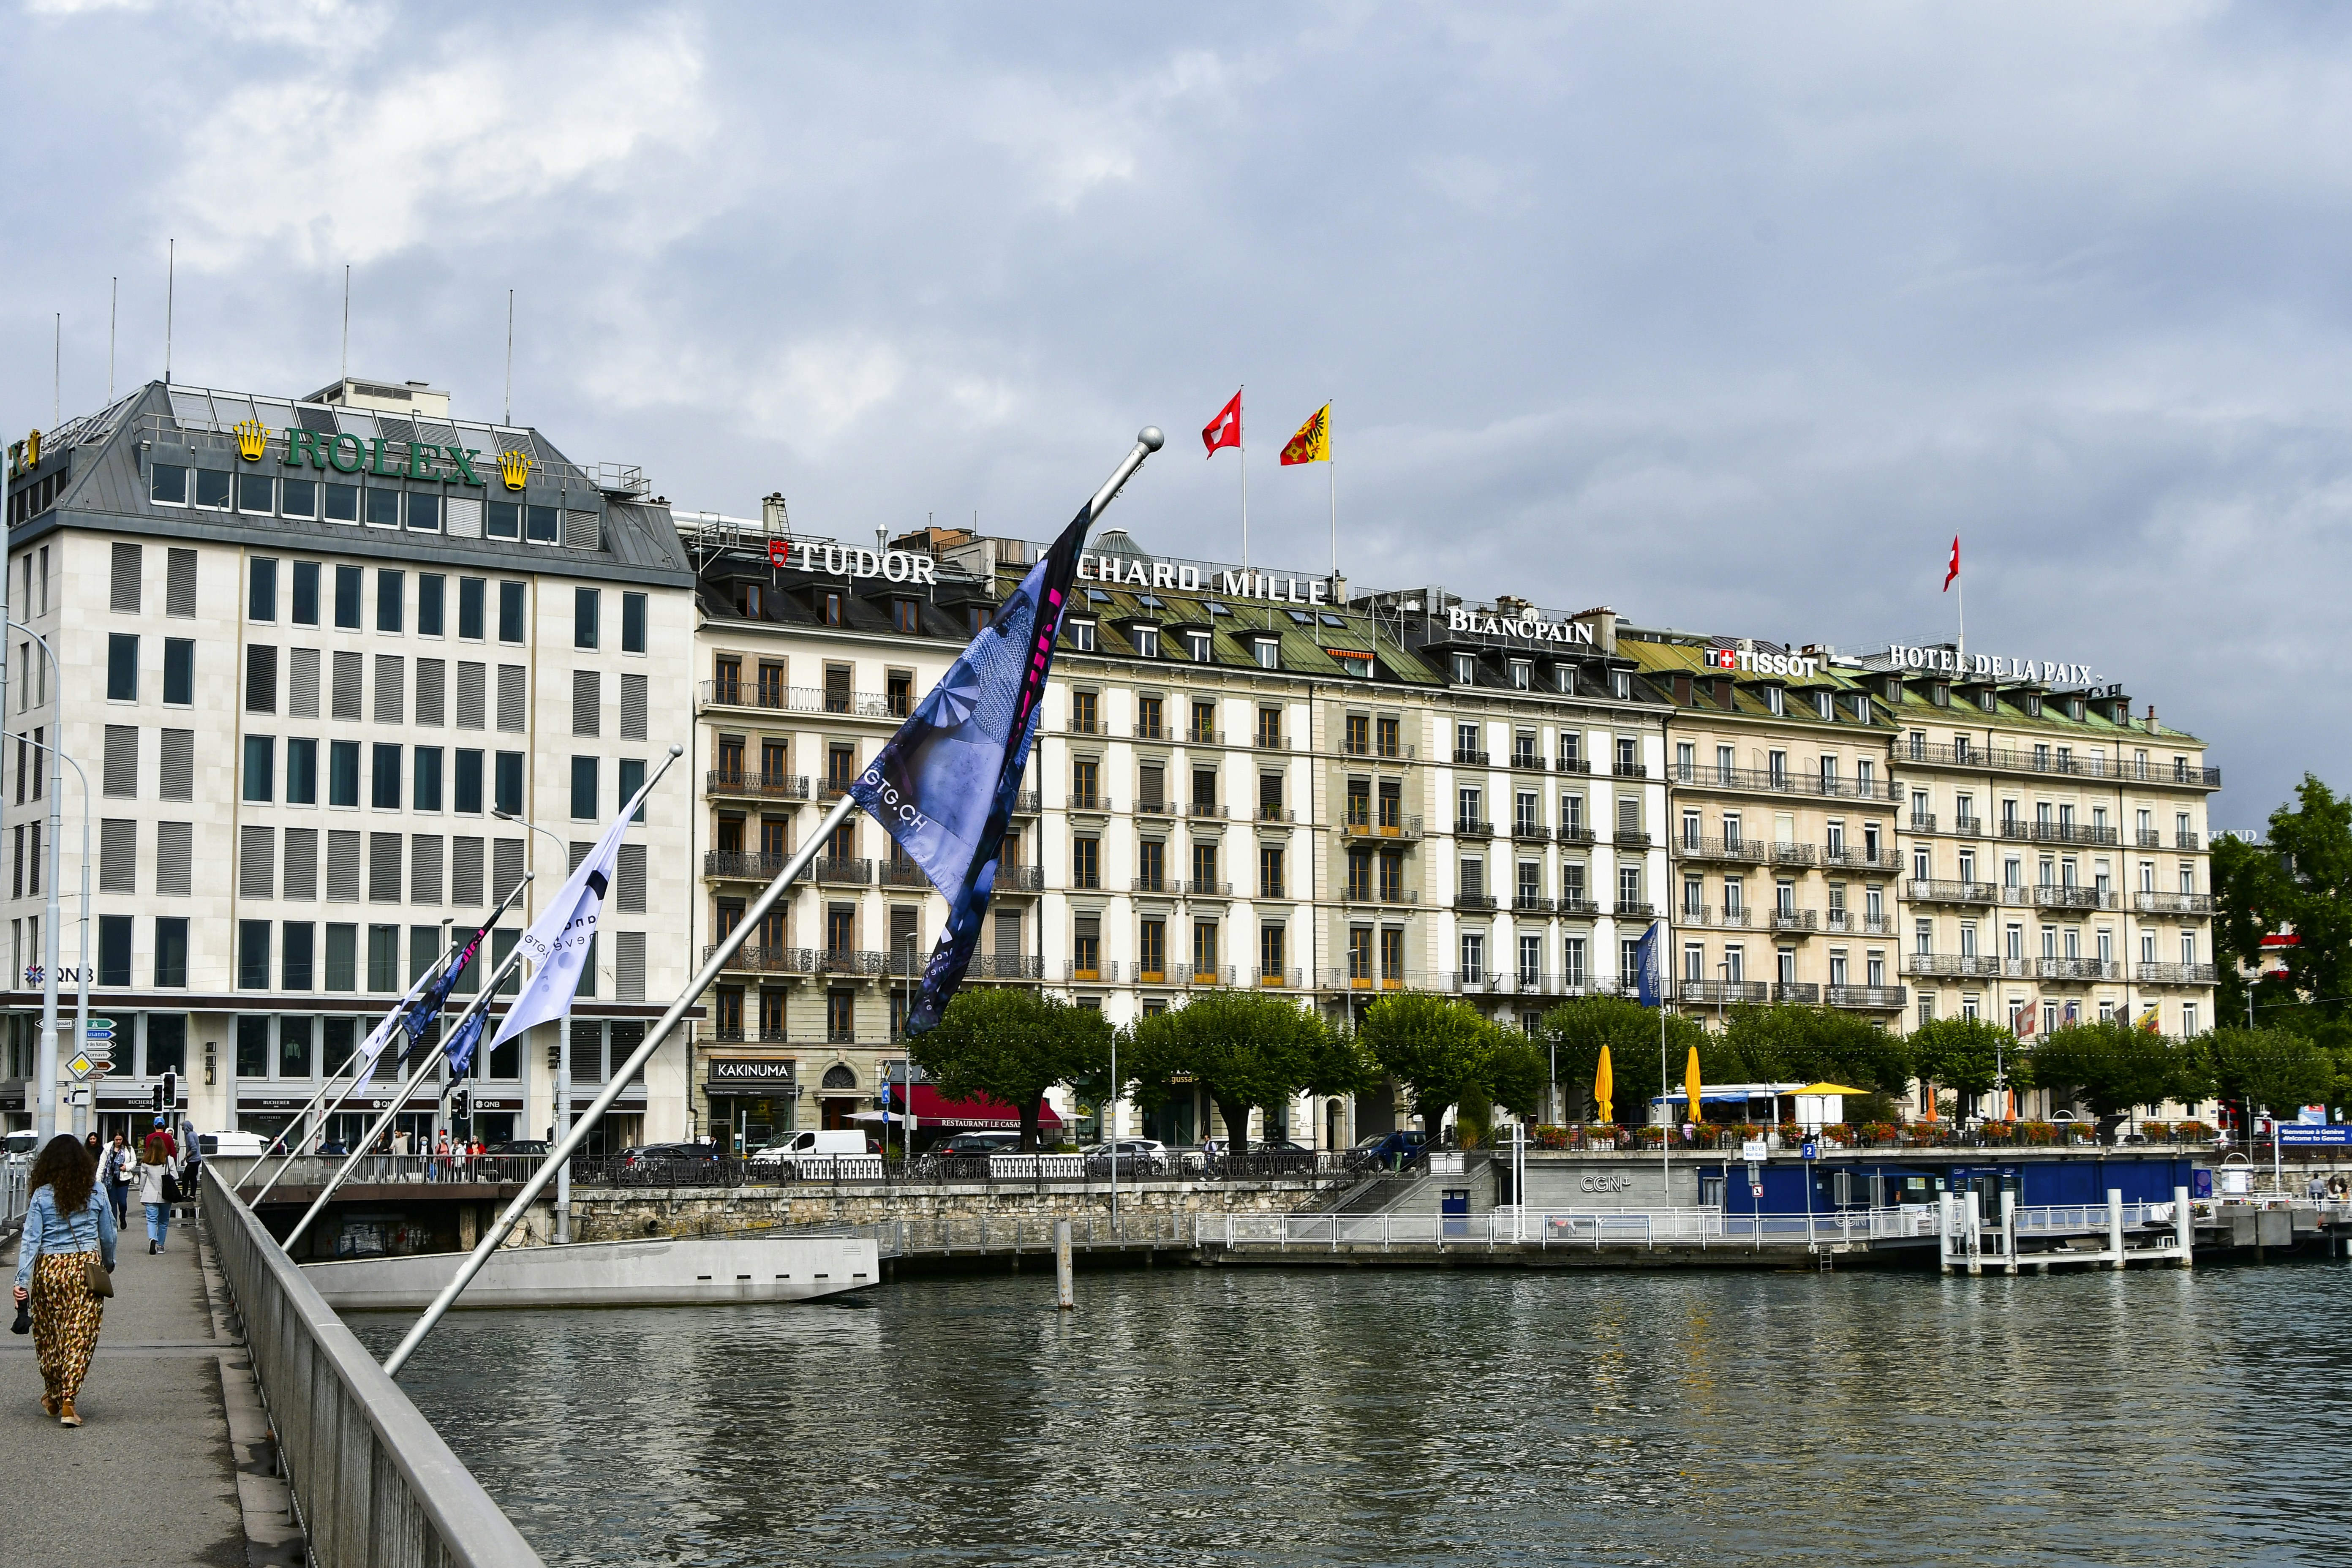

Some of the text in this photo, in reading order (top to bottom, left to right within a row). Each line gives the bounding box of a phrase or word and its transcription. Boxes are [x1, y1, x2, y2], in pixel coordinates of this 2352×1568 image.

[284, 427, 483, 486] ROLEX
[794, 542, 937, 585] TUDOR
[1037, 549, 1326, 606] CHARD MILLE
[1447, 607, 1595, 645] BLANCPAIN
[1736, 650, 1818, 678] TISSOT
[1889, 645, 2092, 685] HOTEL DE LA PAIX
[864, 769, 928, 833] GTG.CH
[525, 935, 550, 958] GTG.
[718, 1064, 788, 1077] KAKINUMA
[1806, 1147, 1812, 1155] 2
[1580, 1176, 1622, 1192] CGN
